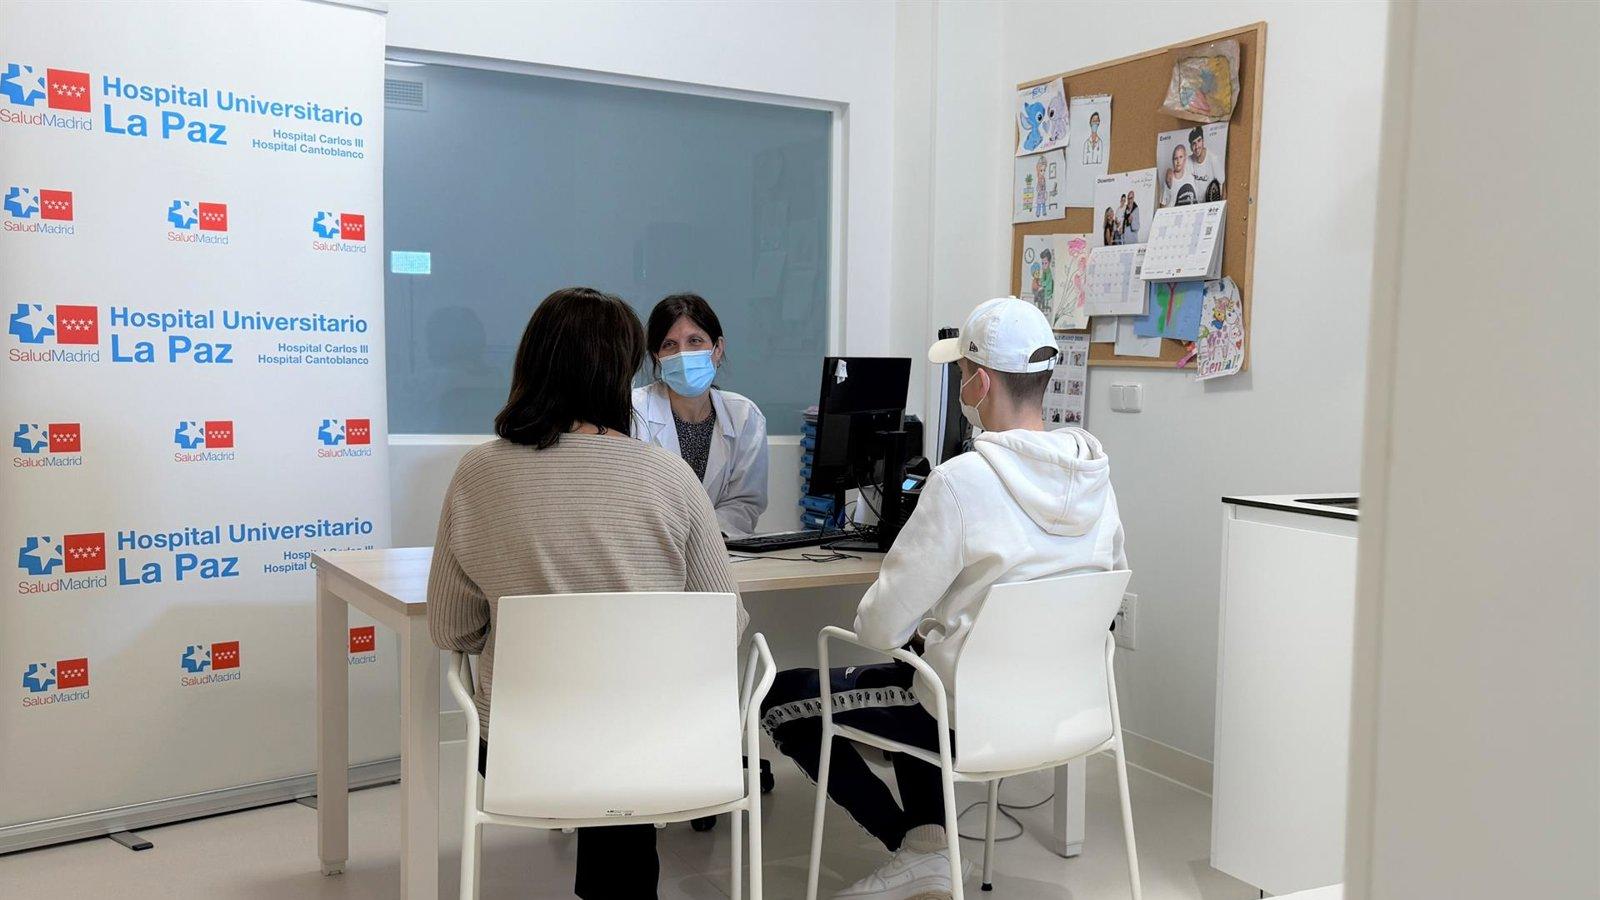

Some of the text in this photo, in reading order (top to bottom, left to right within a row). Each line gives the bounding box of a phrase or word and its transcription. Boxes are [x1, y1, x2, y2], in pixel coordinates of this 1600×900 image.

[103, 75, 363, 126] Hospital Universitario
[0, 108, 92, 131] SaludMadrid
[103, 103, 227, 145] La Paz
[273, 129, 363, 147] Hospital Carlos III
[253, 139, 365, 159] Hospital Cantoblanco
[4, 220, 74, 235] SaludMadrid
[168, 231, 229, 245] SaludMadrid
[313, 241, 366, 253] SaludMadrid
[110, 306, 367, 333] Hospital Universitario
[9, 348, 100, 363] SaludMadrid
[112, 333, 233, 364] La Paz
[278, 343, 368, 355] Hospital Carlos III
[258, 354, 368, 365] Hospital Cantoblanco
[174, 451, 235, 462] SaludMadrid
[317, 447, 372, 458] SaludMadrid
[13, 456, 82, 468] SaludMadrid
[118, 517, 373, 551] Hospital Universitario
[119, 553, 239, 586] La Paz
[264, 562, 307, 573] Hospital
[18, 576, 107, 594] SaludMadrid
[346, 655, 376, 665] Madrid
[182, 671, 241, 687] SaludMadrid
[23, 690, 90, 707] SaludMadrid
